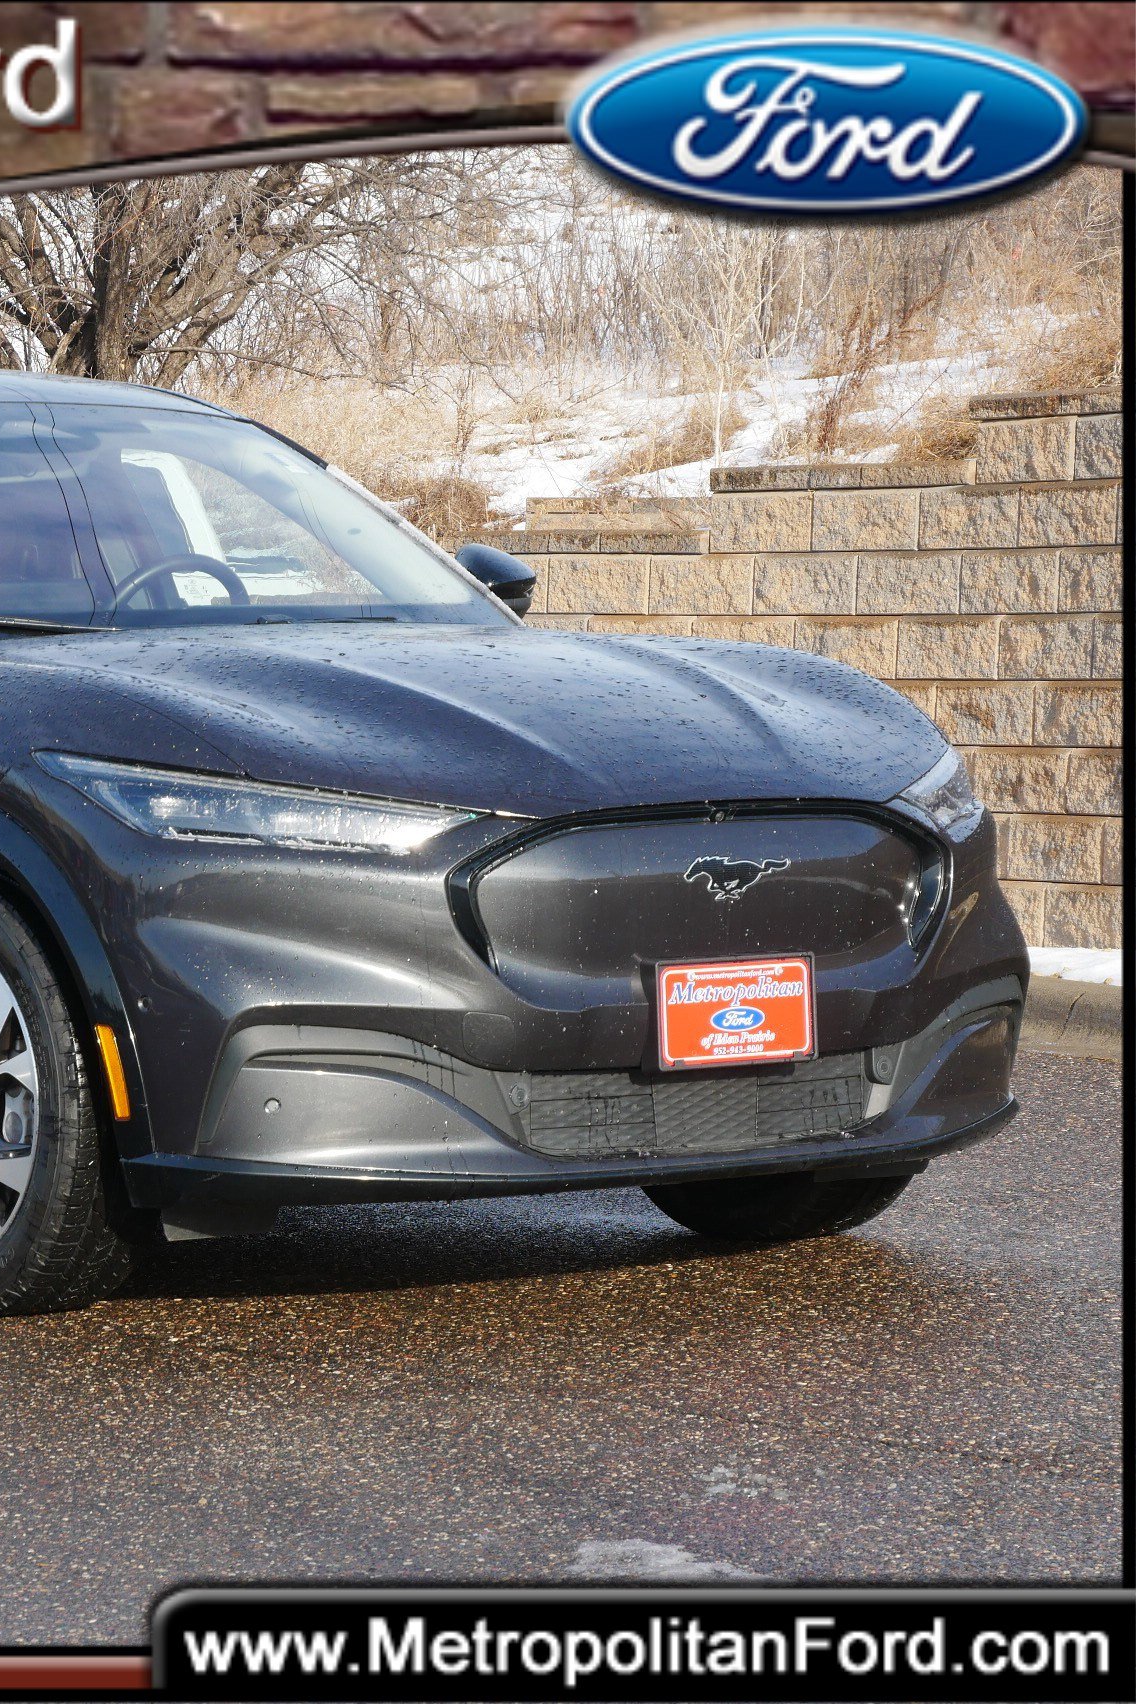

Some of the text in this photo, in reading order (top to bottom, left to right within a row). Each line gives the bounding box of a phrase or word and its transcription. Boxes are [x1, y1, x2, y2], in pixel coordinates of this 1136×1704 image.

[668, 976, 804, 1006] Metropolitan
[722, 1011, 754, 1027] Ford
[701, 1030, 776, 1049] of Eden Prairie
